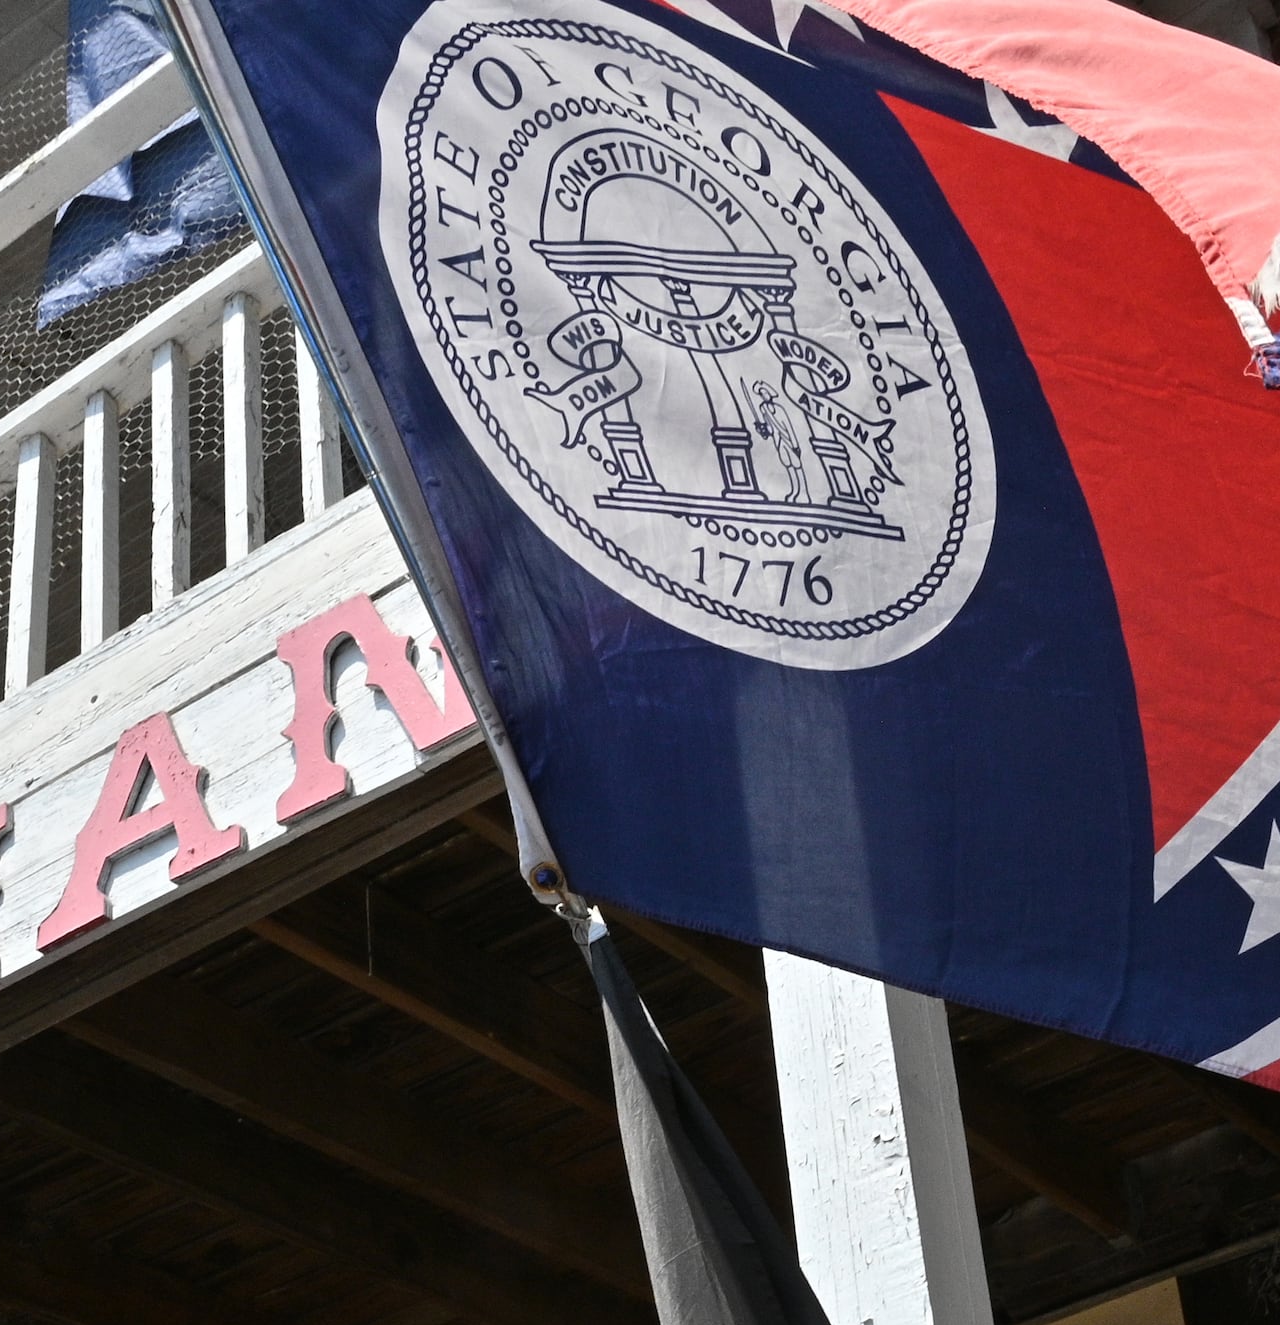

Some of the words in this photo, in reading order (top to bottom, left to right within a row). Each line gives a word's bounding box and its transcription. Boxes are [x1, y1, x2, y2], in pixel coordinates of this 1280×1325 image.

[471, 45, 562, 112] OF
[554, 140, 743, 227] CONSTITUTION
[437, 131, 513, 381] STATE
[593, 61, 932, 400] GEORGIA
[561, 317, 606, 350] WIS
[626, 308, 752, 348] JUSTICE
[773, 337, 844, 388] MODER
[568, 375, 618, 412] DOM
[798, 393, 870, 445] ATION
[691, 546, 834, 607] 1776
